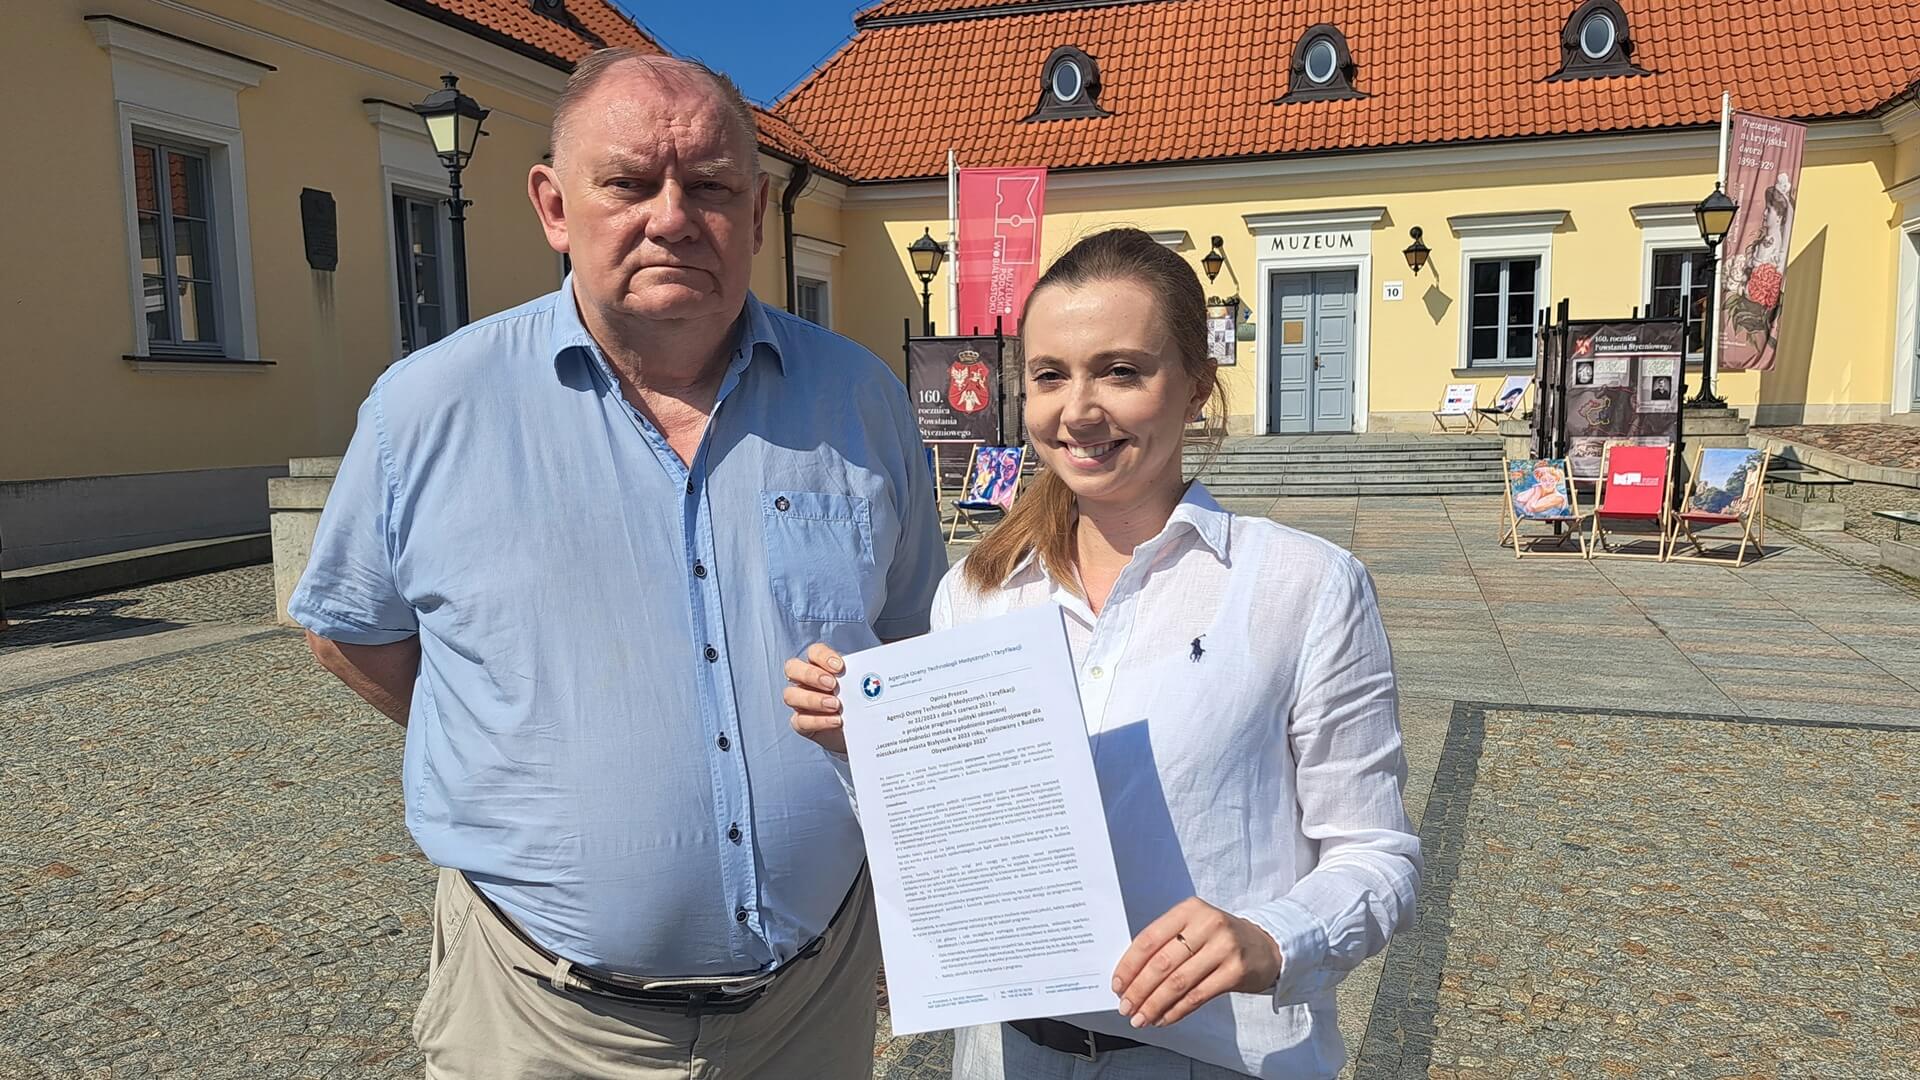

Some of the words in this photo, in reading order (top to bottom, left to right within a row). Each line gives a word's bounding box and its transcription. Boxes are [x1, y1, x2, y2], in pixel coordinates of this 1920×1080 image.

[1742, 119, 1781, 134] Prezentacje
[1272, 232, 1354, 251] MUZEUM
[988, 257, 1000, 315] BIAŁYMSTOKU
[996, 267, 1008, 315] PODLASKIE
[1003, 267, 1015, 306] MUZEUM
[1387, 288, 1399, 297] 10
[1595, 335, 1609, 343] 160.
[1610, 334, 1637, 343] rocznica
[1595, 343, 1627, 351] Powstania
[1629, 342, 1672, 351] Styczniowego
[919, 390, 944, 403] 160.
[918, 405, 950, 414] rocznica
[918, 416, 957, 425] Powstania
[920, 428, 971, 438] Styczniowego
[993, 644, 1022, 655] Taryfikacji
[929, 694, 947, 702] Opinia
[948, 689, 968, 698] Prezesa
[887, 712, 905, 722] Agencji
[905, 709, 922, 717] Oceny
[923, 701, 953, 713] Technologii
[953, 694, 985, 705] Medycznych
[988, 686, 1016, 697] Taryfikacji
[958, 704, 978, 713] czerwca
[979, 700, 992, 708] 2023
[906, 724, 930, 735] projekcie
[931, 719, 957, 729] programu
[958, 713, 977, 723] polityki
[977, 706, 1007, 717] zdrowotnej
[898, 733, 931, 744] niepłodności
[932, 728, 952, 736] metodą
[986, 711, 1031, 725] pozaustrojowego
[926, 737, 951, 747] Białystok
[957, 732, 970, 740] 2023
[1021, 717, 1044, 726] Budżetu
[931, 742, 973, 754] Obywatelskiego
